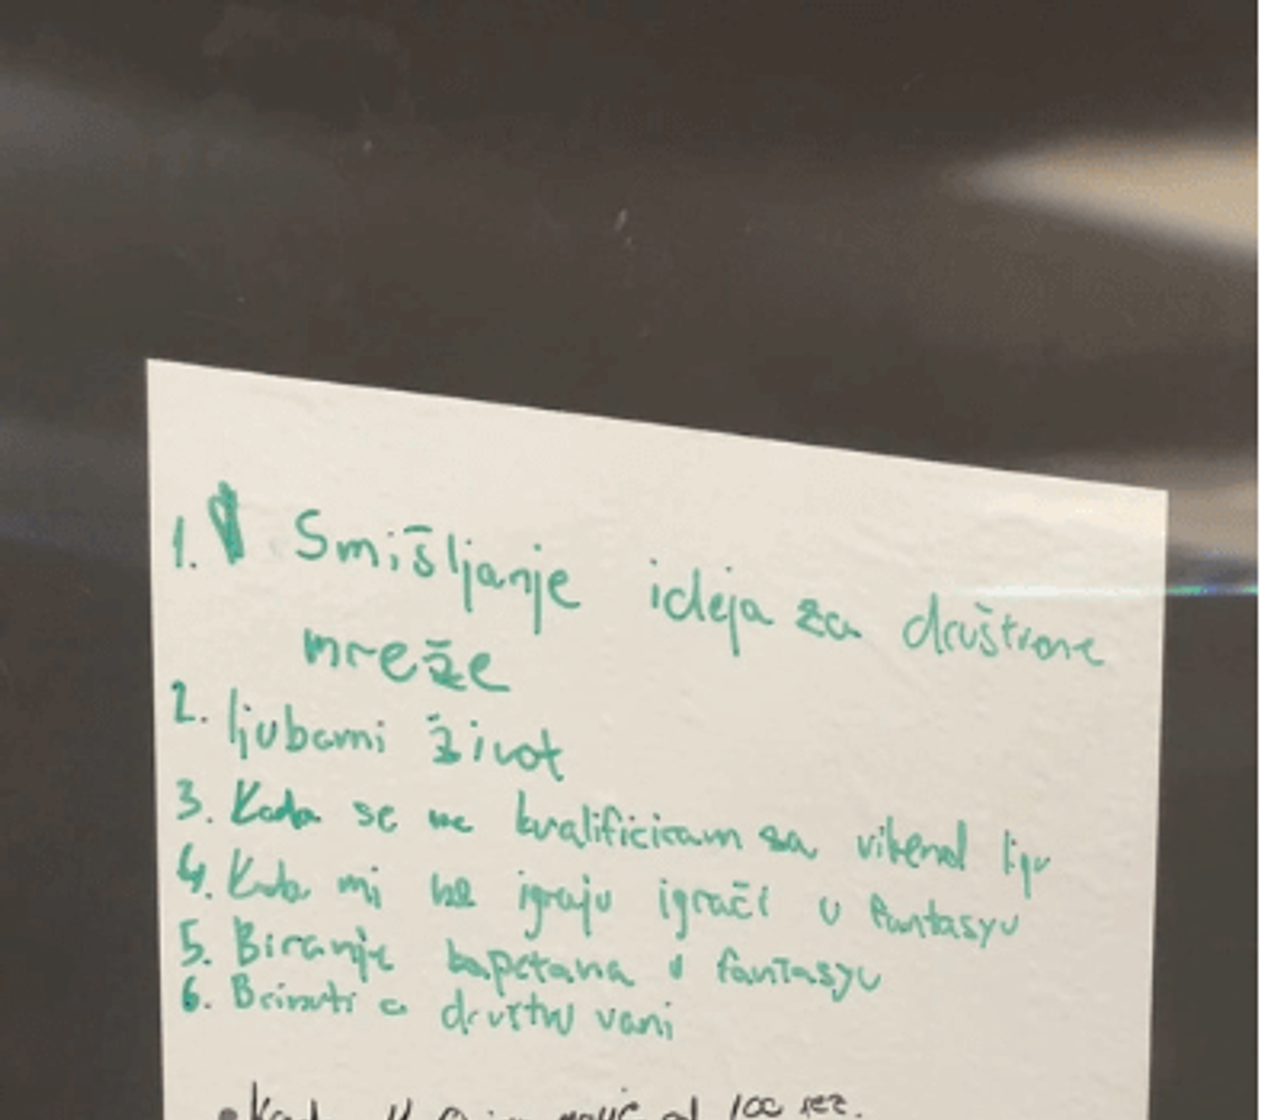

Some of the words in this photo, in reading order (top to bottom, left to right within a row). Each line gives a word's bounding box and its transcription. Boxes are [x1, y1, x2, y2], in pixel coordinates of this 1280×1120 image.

[295, 508, 581, 637] Smišljanje
[650, 557, 774, 656] ideja
[303, 627, 510, 692] mreže
[428, 713, 564, 782] život
[353, 800, 399, 833] se
[819, 896, 840, 926] u
[178, 918, 213, 967] 5.
